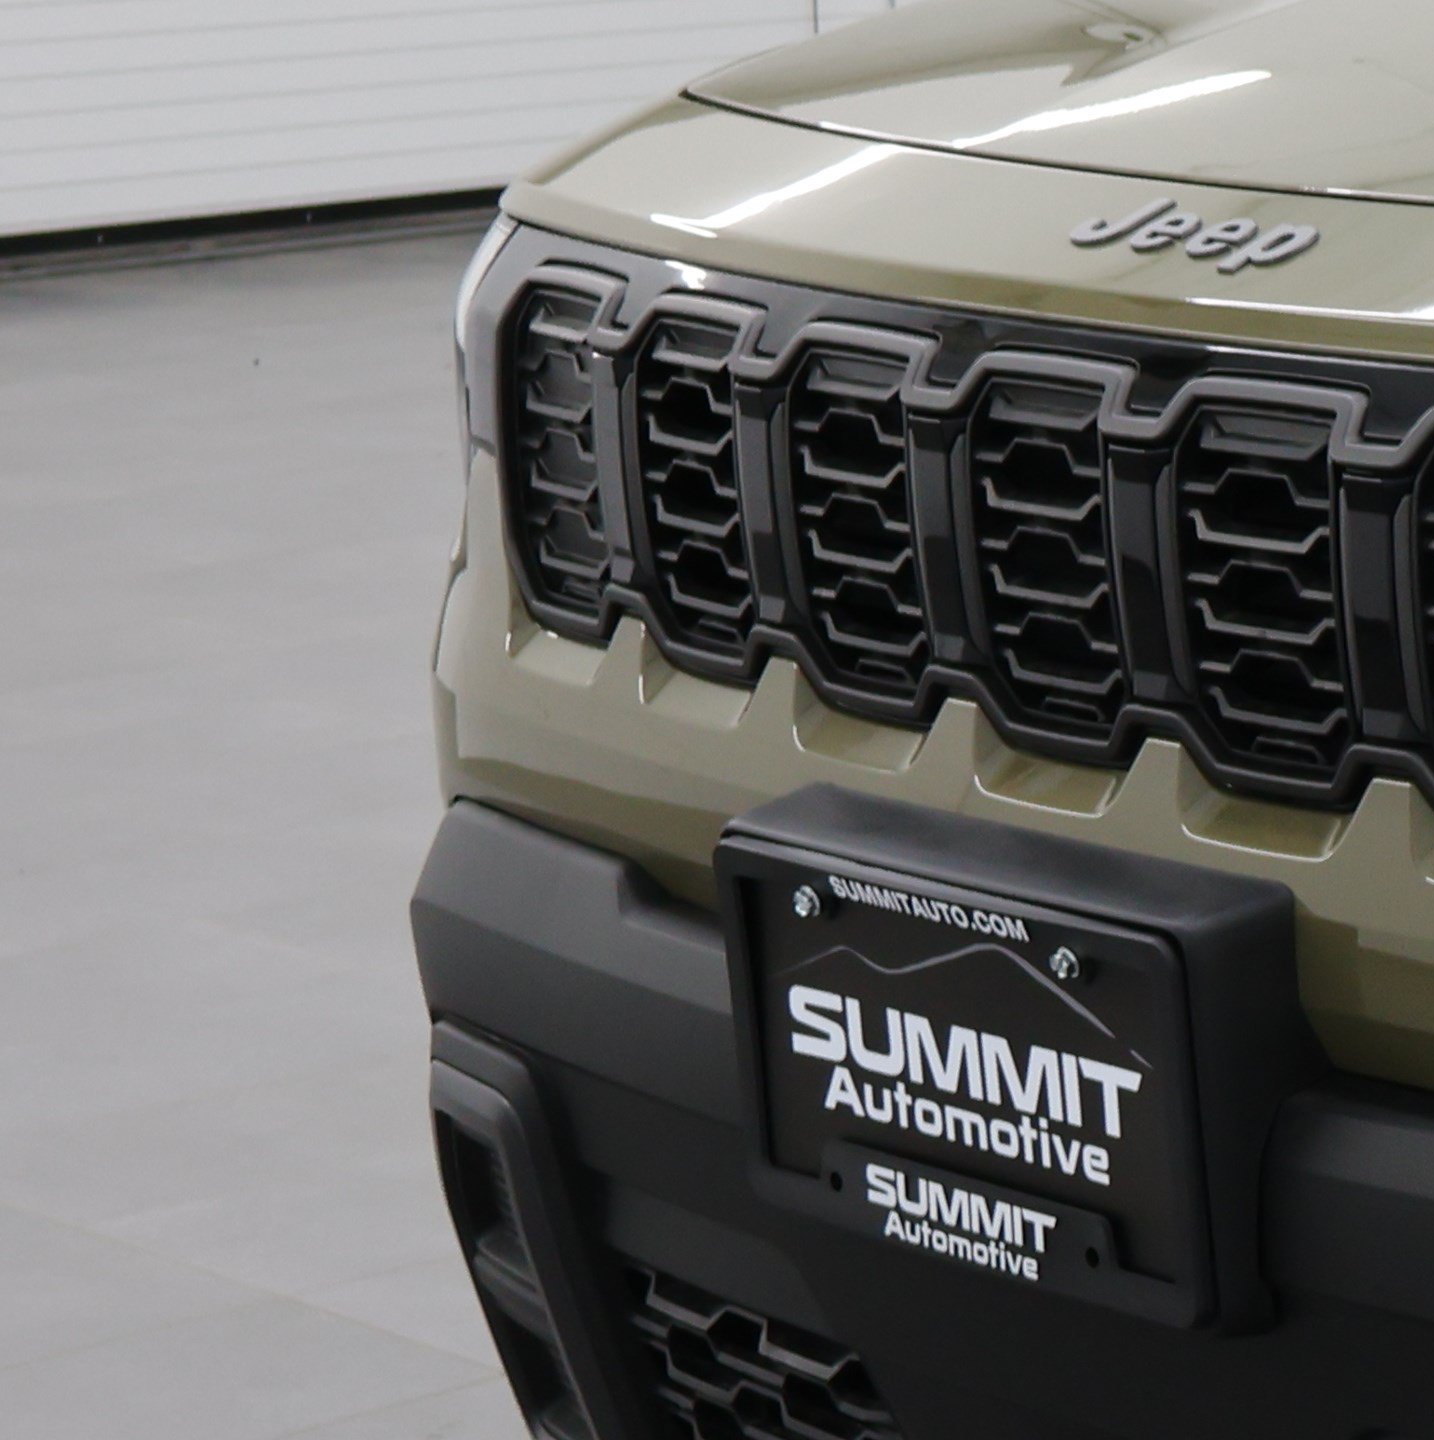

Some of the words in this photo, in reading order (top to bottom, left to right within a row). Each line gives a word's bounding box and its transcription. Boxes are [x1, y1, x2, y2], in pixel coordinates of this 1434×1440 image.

[1070, 198, 1320, 276] Jeep
[827, 873, 1031, 944] SUMMITAUTO.COM
[788, 983, 1142, 1140] SUMMIT
[824, 1065, 1111, 1186] Automotive
[865, 1163, 1057, 1254] SUMMIT
[884, 1210, 1040, 1283] Automotive
